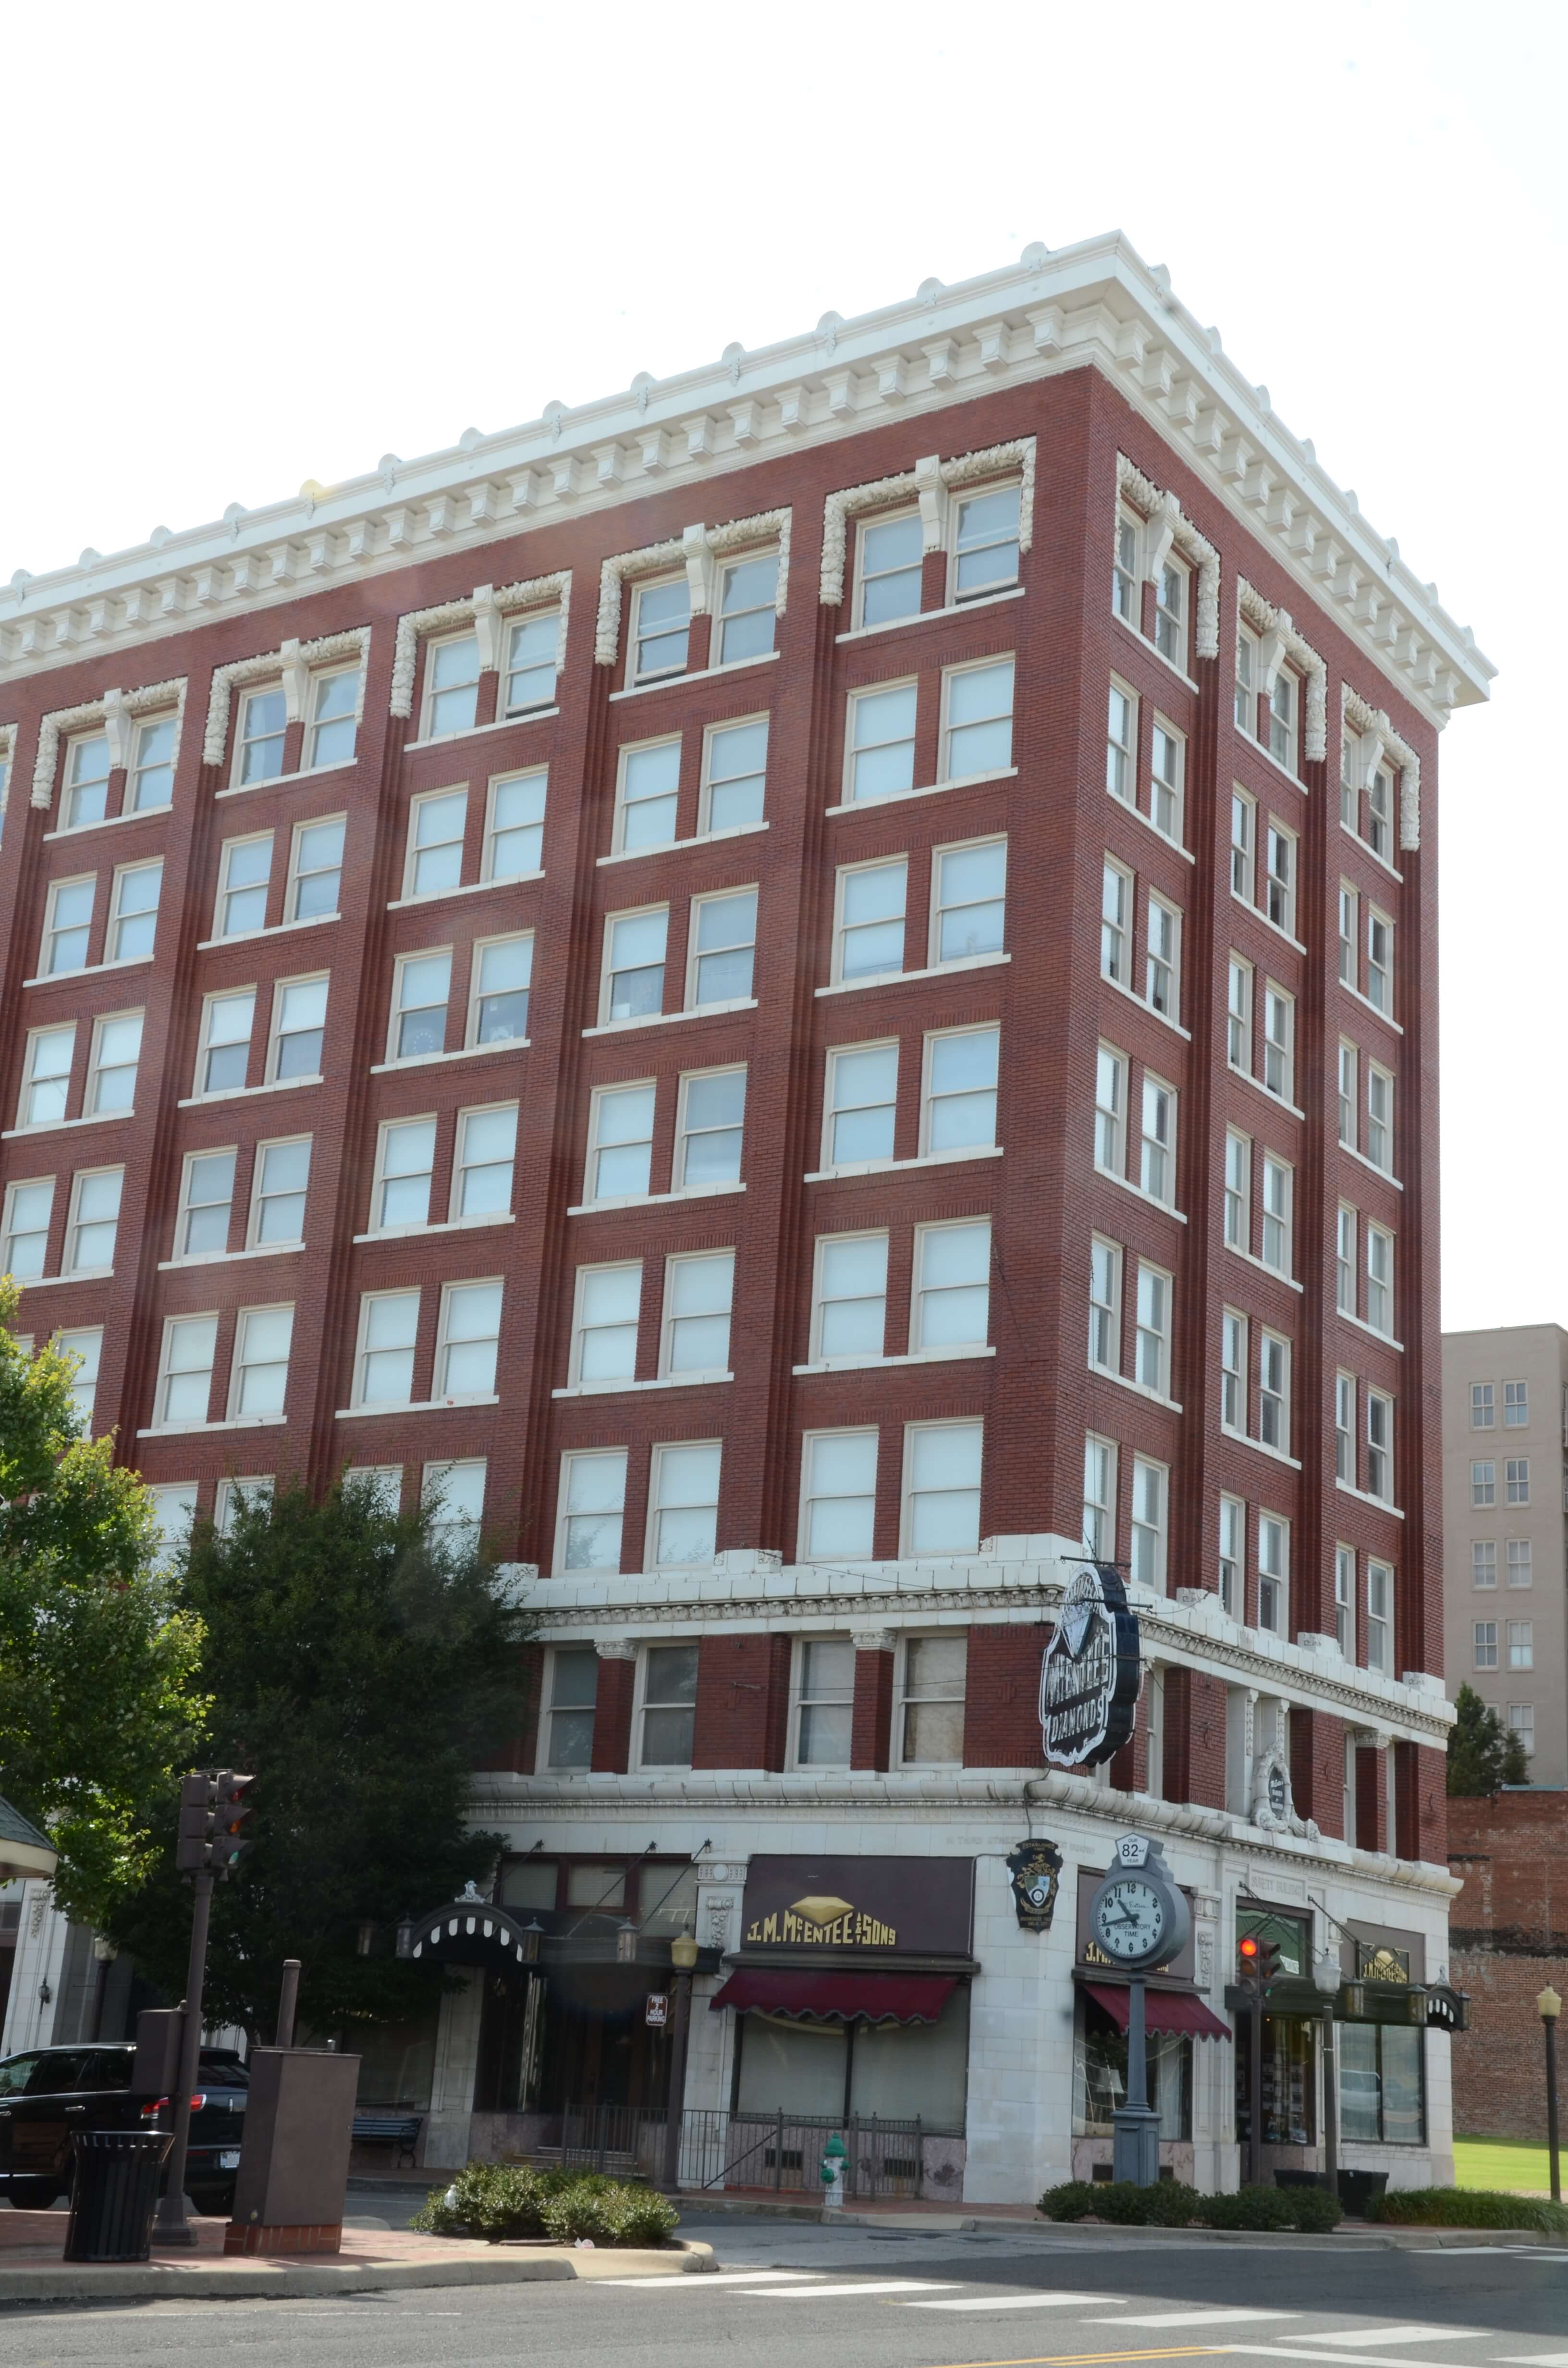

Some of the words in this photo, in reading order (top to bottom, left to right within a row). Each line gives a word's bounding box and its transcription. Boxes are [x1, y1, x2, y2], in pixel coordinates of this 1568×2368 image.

[1051, 1696, 1102, 1743] DIAMONDS
[1114, 1886, 1121, 1898] 11
[1105, 1898, 1113, 1908] 10
[1155, 1913, 1161, 1924] 3
[862, 1914, 896, 1945] SONS
[1106, 1928, 1111, 1938] 8
[1129, 1942, 1133, 1953] 6
